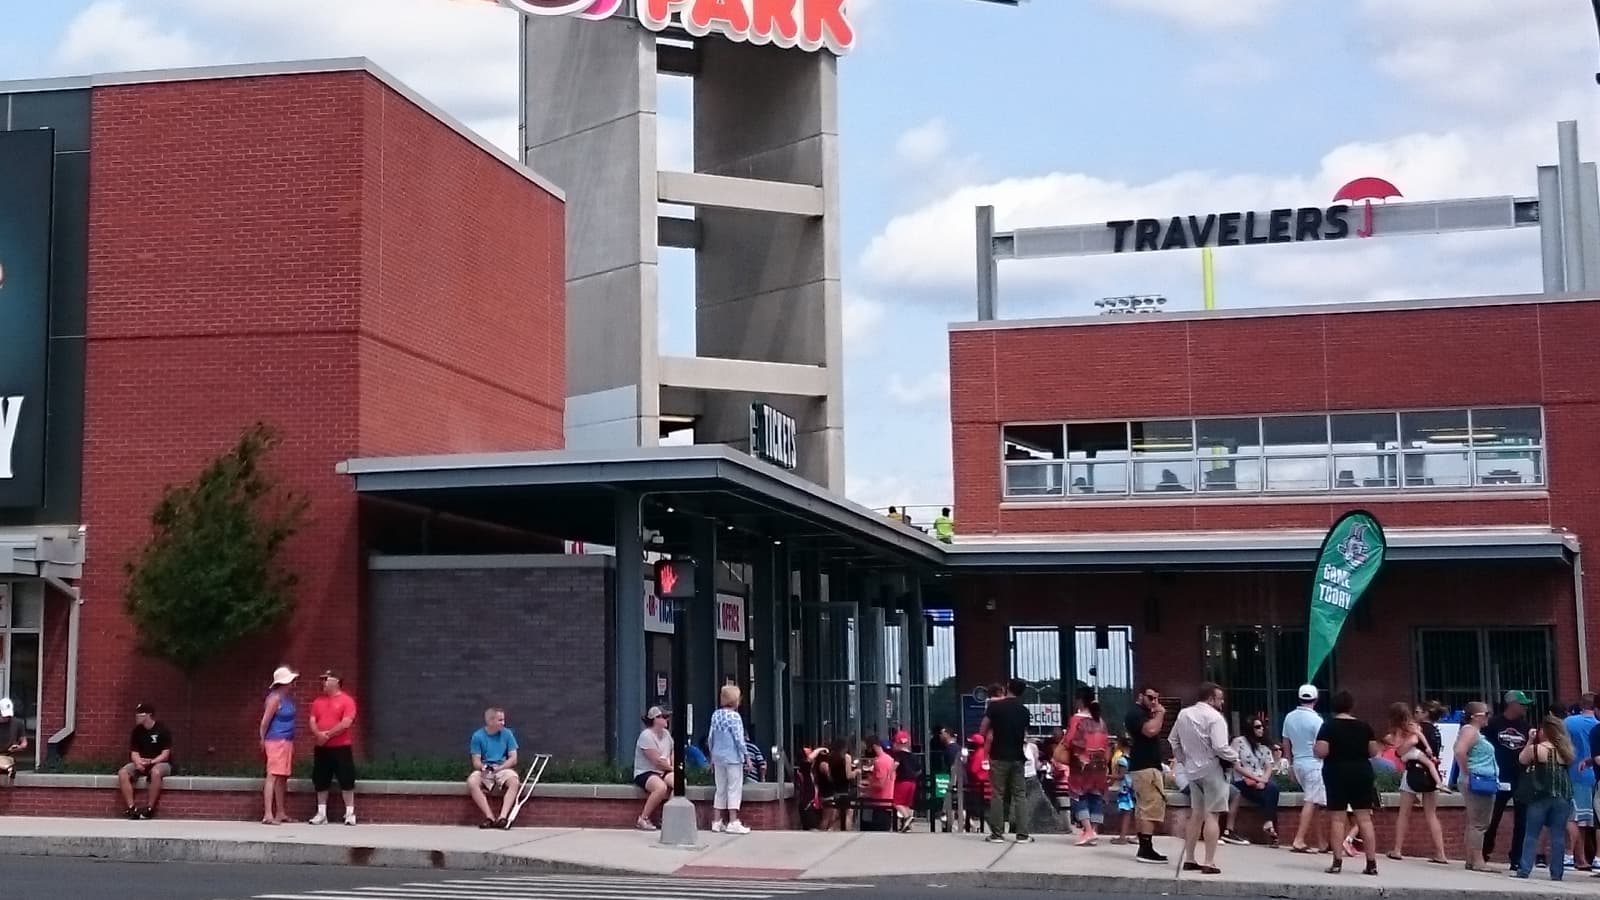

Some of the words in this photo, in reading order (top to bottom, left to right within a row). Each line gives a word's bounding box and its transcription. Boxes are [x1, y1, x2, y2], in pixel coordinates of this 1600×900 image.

[1106, 205, 1349, 253] TRAVELERS
[763, 404, 797, 468] TICKETS
[1323, 563, 1351, 589] GAME
[1319, 583, 1352, 610] TODAY
[721, 602, 740, 633] OFFICE
